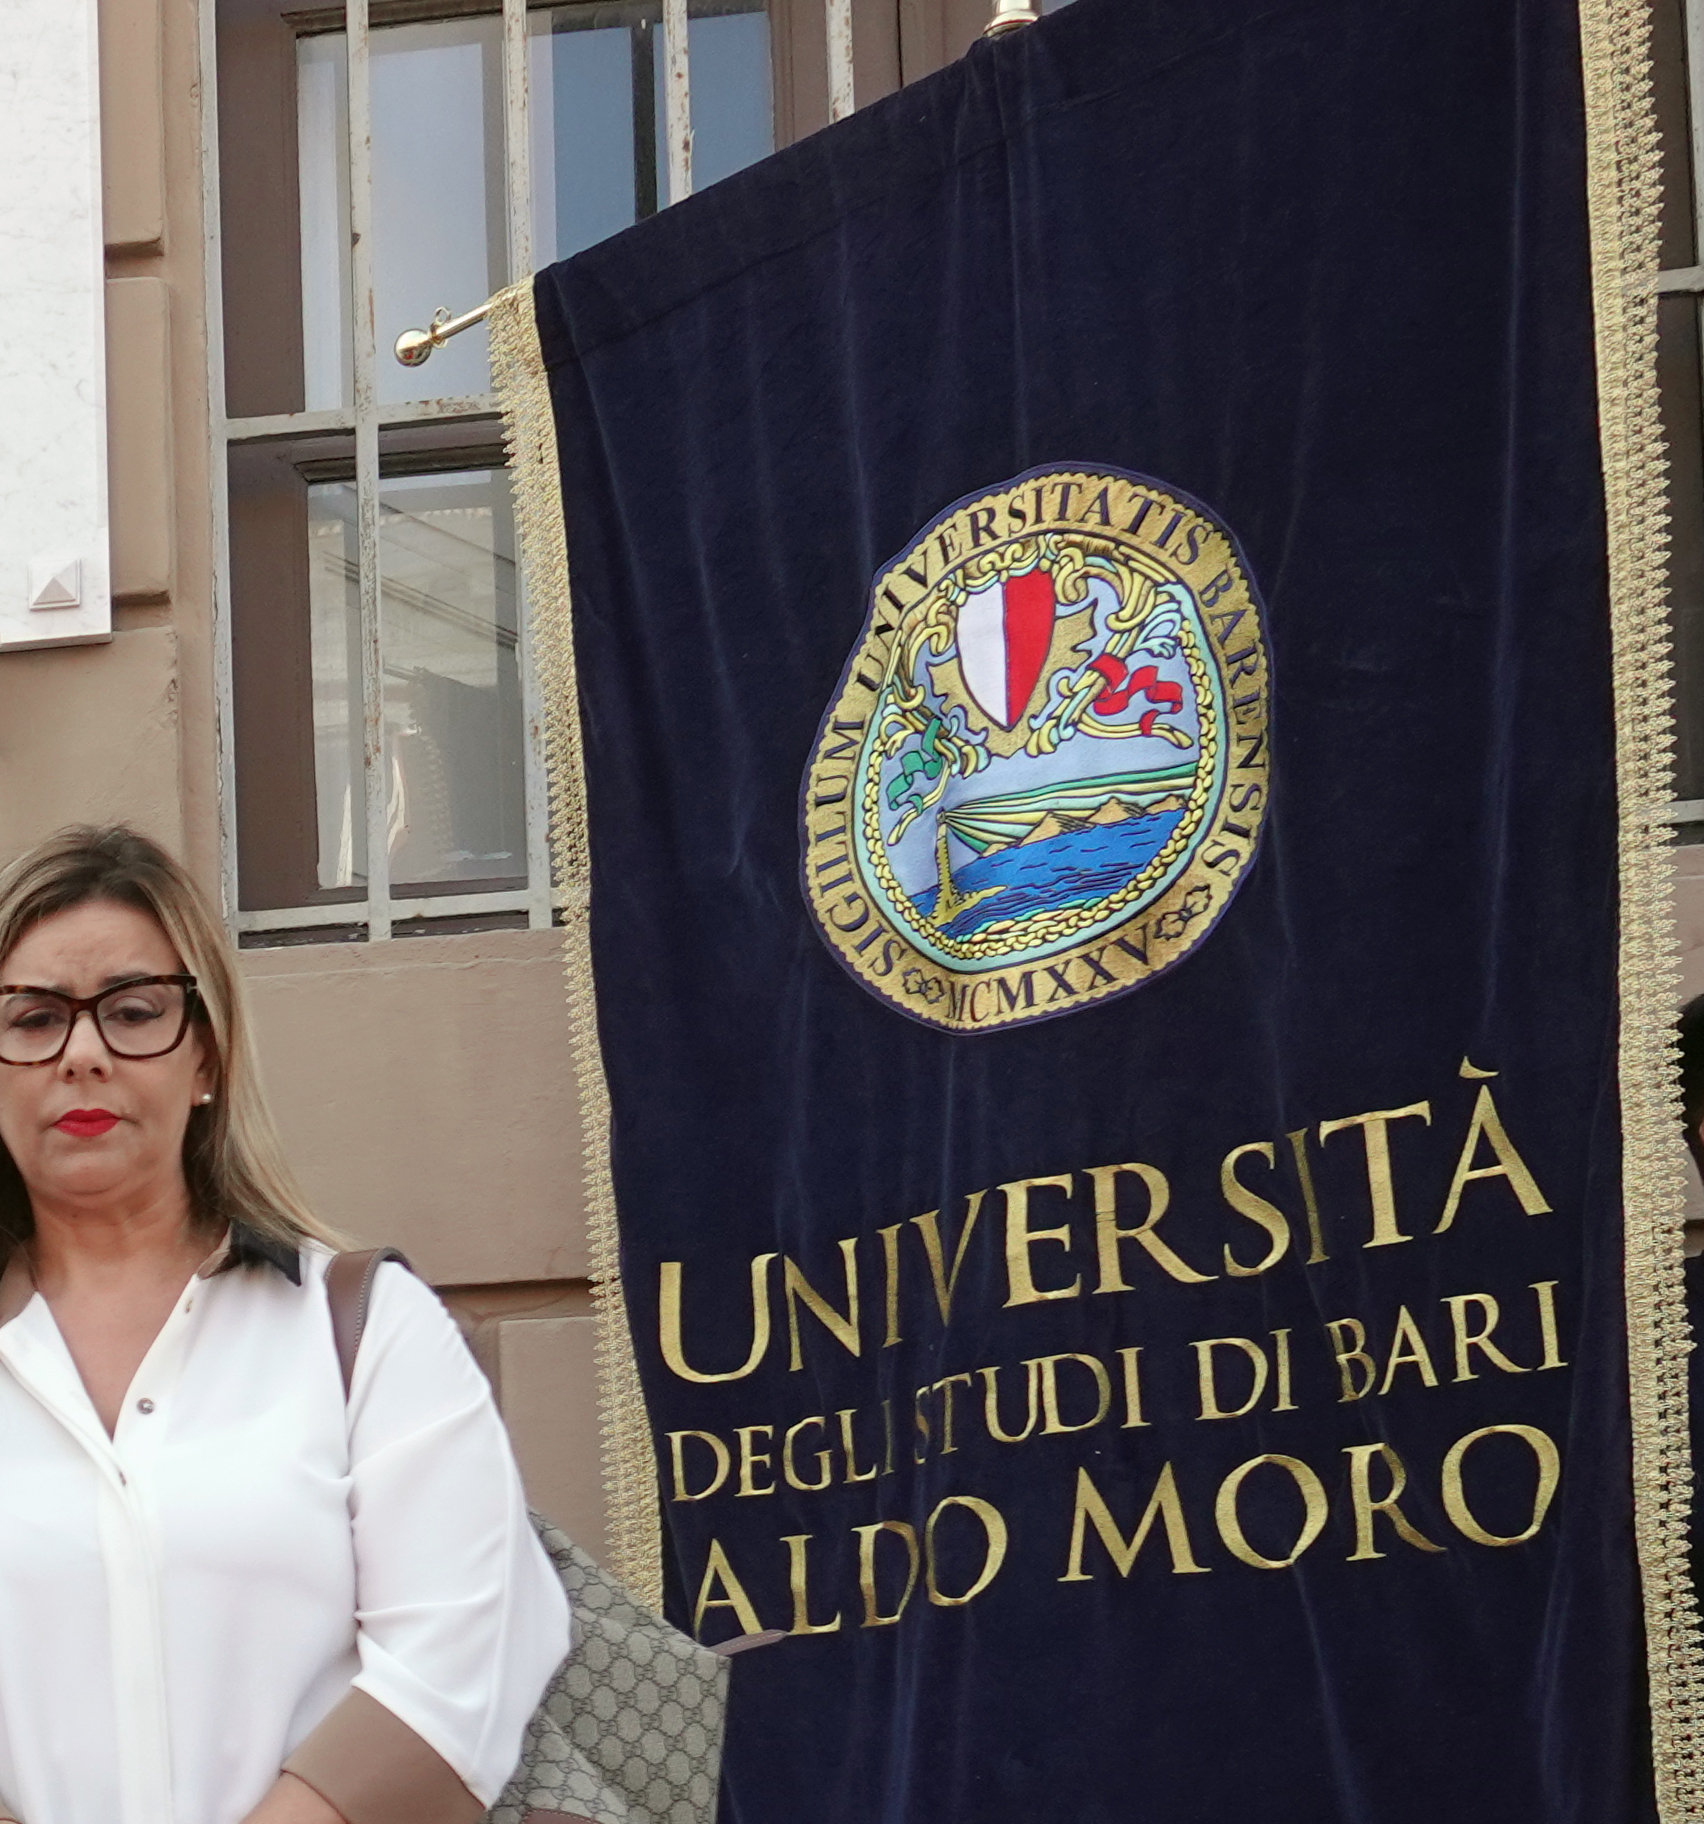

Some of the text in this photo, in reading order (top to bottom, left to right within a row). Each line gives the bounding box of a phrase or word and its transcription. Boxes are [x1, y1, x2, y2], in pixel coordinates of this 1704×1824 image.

[813, 481, 1268, 976] SIGILLUM UNIVERSITATIS BARENSIS
[945, 926, 1154, 1024] MCMXXV
[658, 1056, 1553, 1384] UNIVERSITÀ
[669, 1280, 1569, 1503] DEGLI STUDI DI BARI
[693, 1423, 1562, 1640] ALDO MORO
